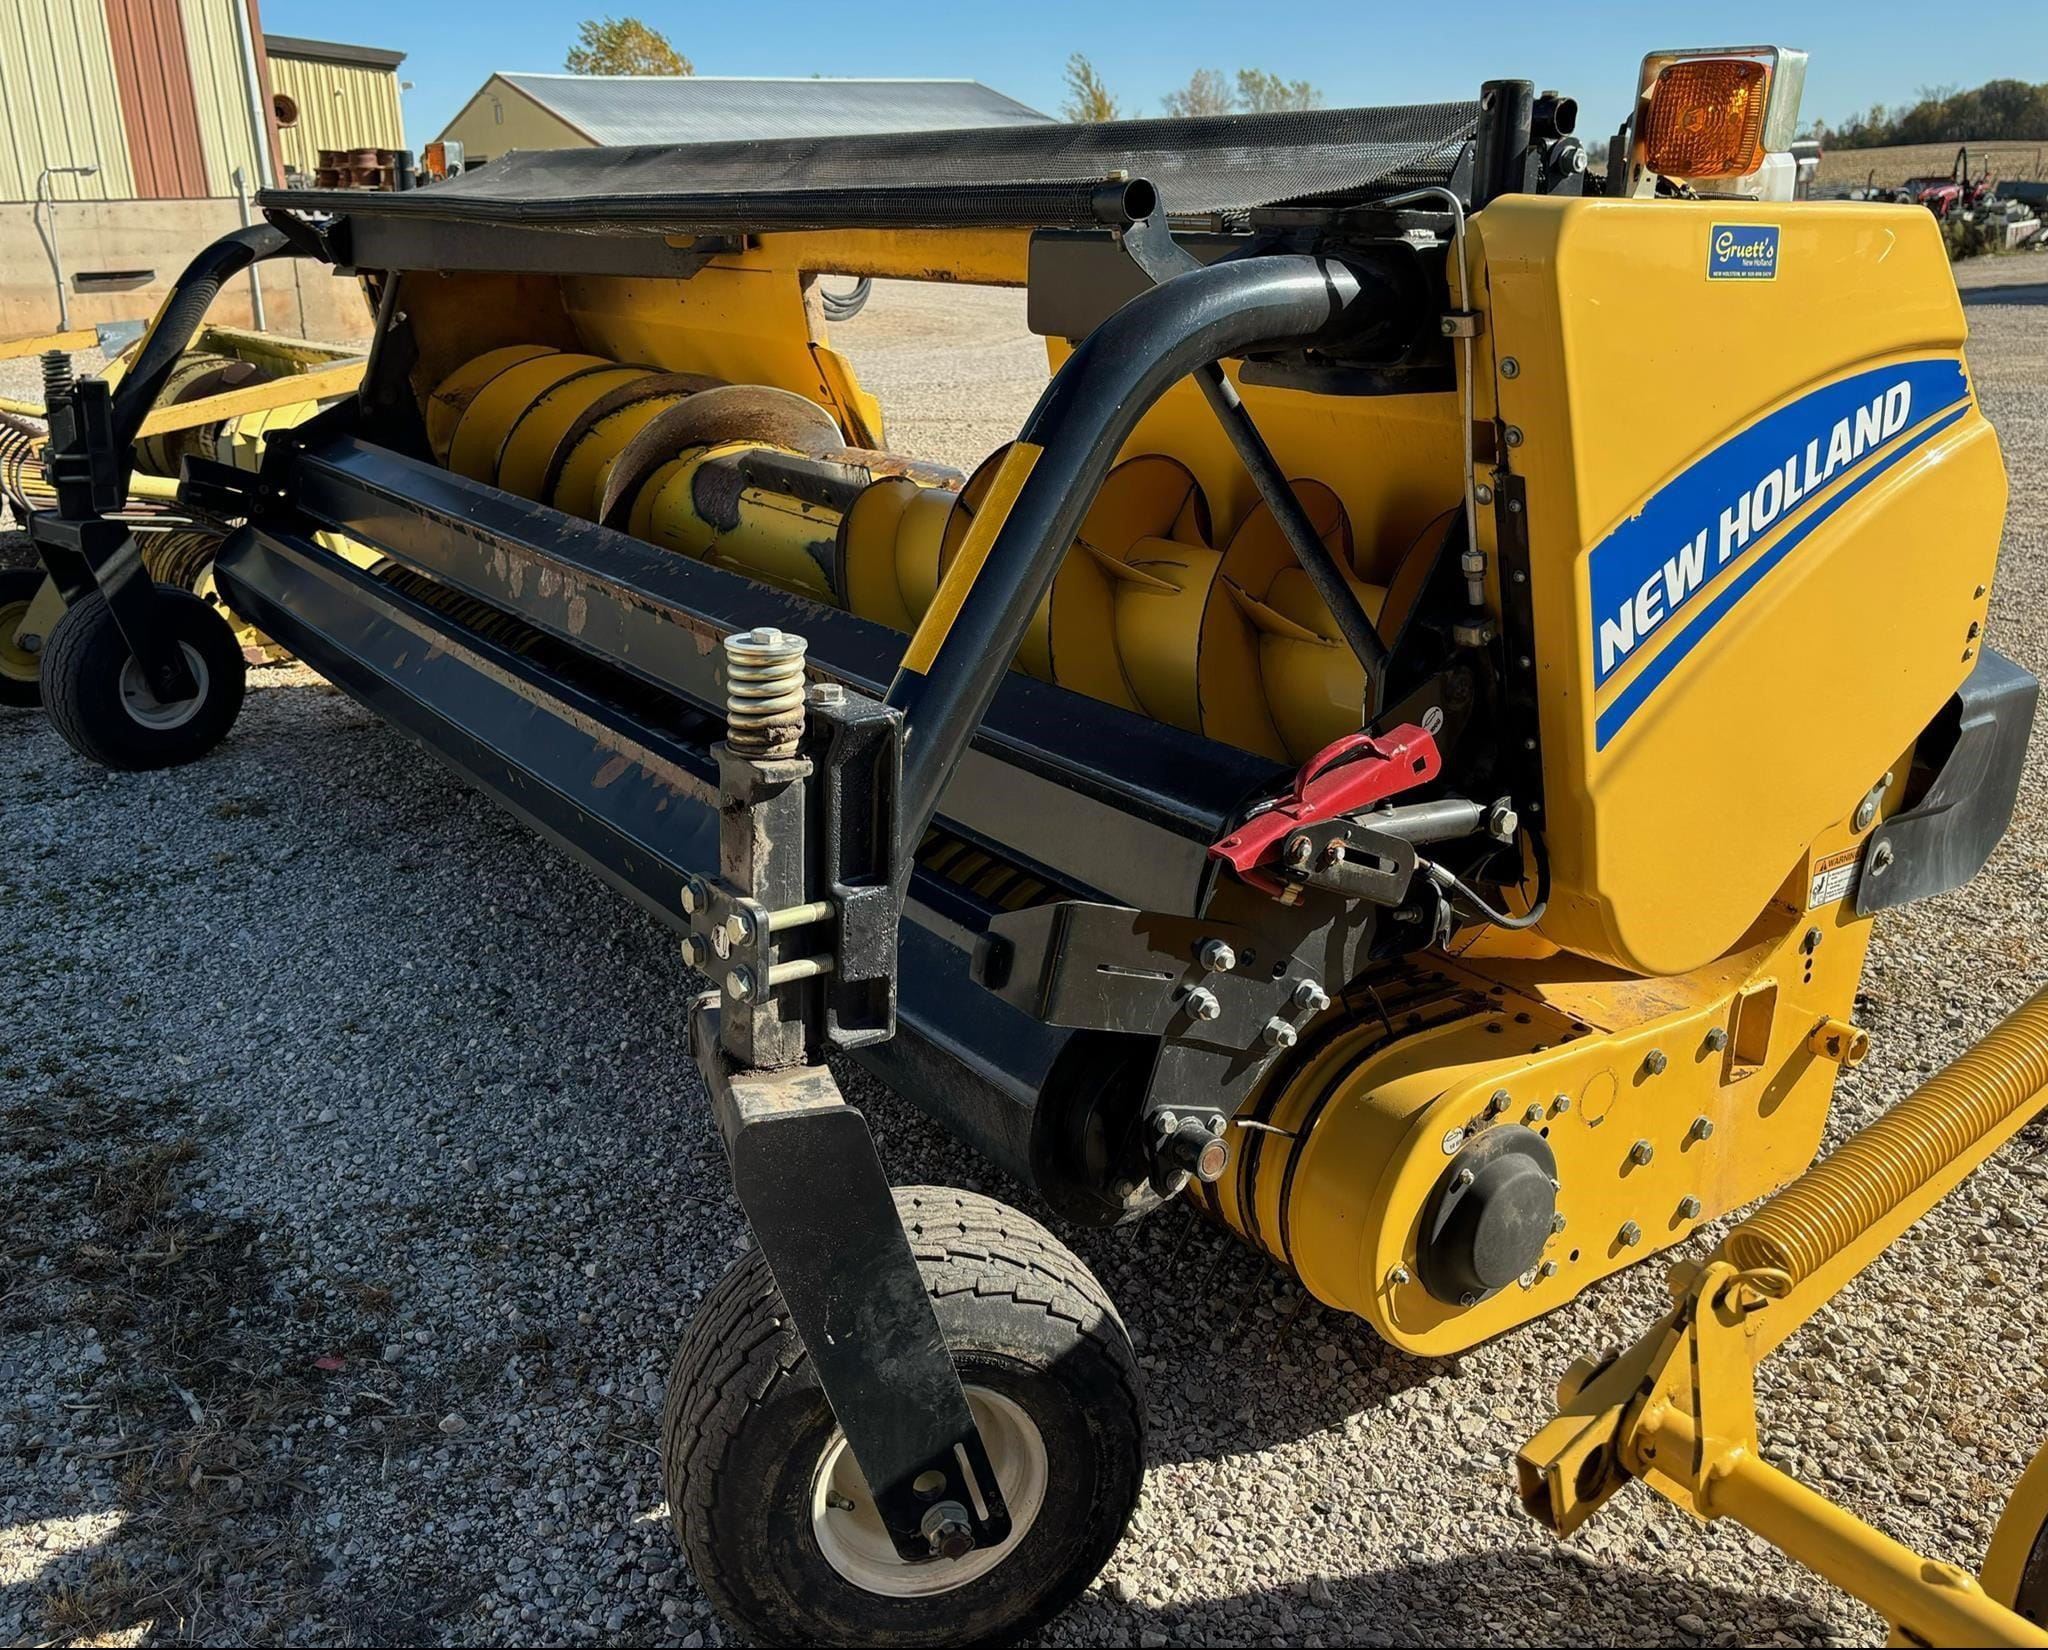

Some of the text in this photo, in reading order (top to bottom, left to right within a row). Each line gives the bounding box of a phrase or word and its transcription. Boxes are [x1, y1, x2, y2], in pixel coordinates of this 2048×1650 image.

[1715, 231, 1774, 262] Gruett's
[1753, 258, 1773, 267] Holland
[1600, 380, 1911, 675] NEW HOLLAND
